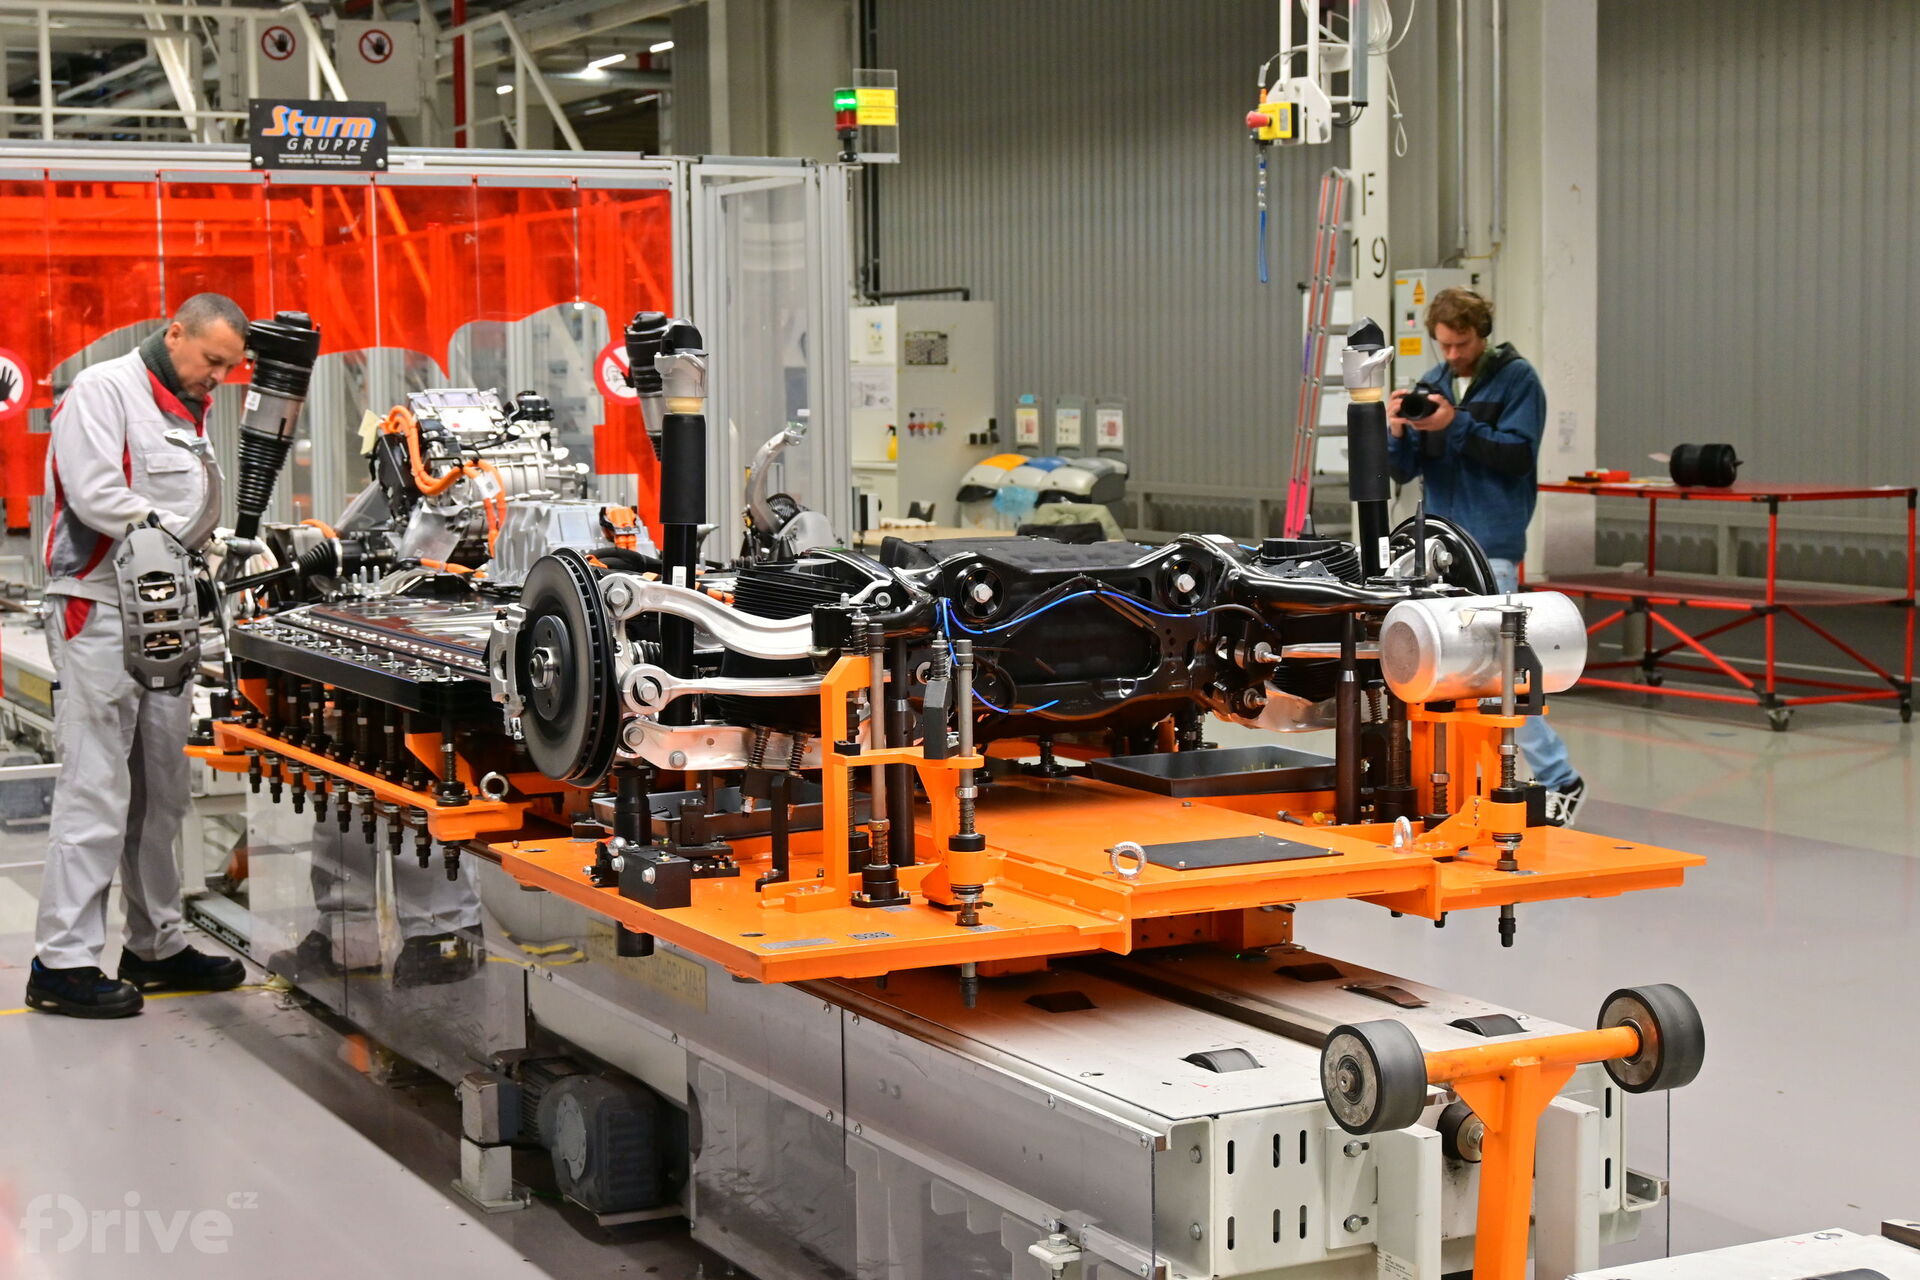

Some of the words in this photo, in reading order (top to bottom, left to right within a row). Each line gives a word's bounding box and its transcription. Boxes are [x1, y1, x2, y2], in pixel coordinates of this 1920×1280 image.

[261, 105, 376, 138] Sturm
[286, 138, 370, 152] GRUPPE
[1362, 172, 1375, 216] F
[1352, 236, 1388, 279] 19
